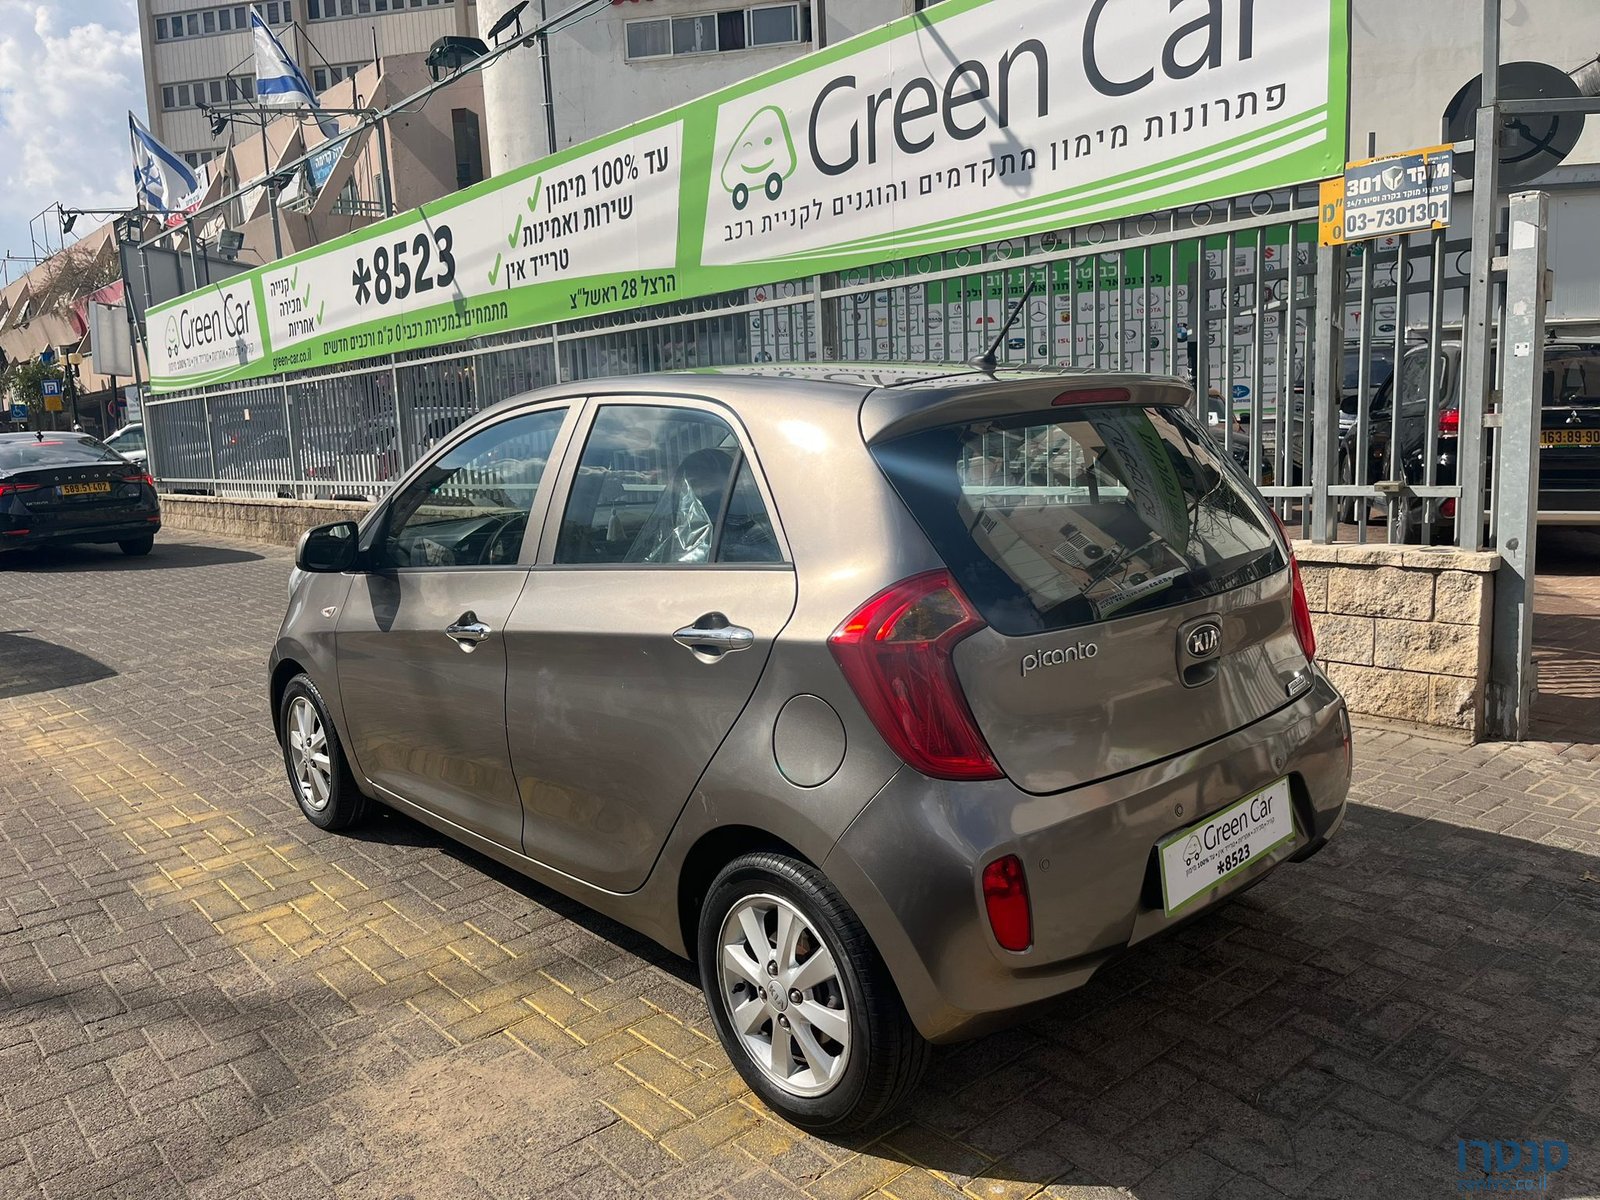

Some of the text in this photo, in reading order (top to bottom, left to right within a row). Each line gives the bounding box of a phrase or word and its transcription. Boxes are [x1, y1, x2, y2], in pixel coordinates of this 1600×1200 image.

[808, 37, 1050, 176] Green
[724, 83, 1286, 241] פתרונות מימון מתקדמים והוגנים לקניית רכב
[545, 146, 669, 213] עד 100% מימון
[1346, 174, 1381, 197] 301
[523, 194, 633, 247] שירות ואמינות
[1346, 199, 1448, 233] 03-7301301
[505, 248, 569, 289] טרייד אין
[270, 278, 290, 297] קנייה
[621, 279, 637, 301] 28
[640, 273, 676, 297] הרצל
[279, 297, 302, 317] מכירה
[464, 301, 508, 326] מתמחים
[180, 293, 250, 349] Green Car
[288, 317, 315, 337] אחריות
[403, 321, 423, 339] רכבי
[425, 310, 462, 336] במכירת
[323, 337, 349, 355] חדשים
[350, 330, 375, 350] ורכבים
[272, 347, 312, 370] green-car.co.il
[1193, 630, 1218, 653] KIA
[1021, 641, 1098, 677] picanto
[1203, 796, 1273, 850] Green Car
